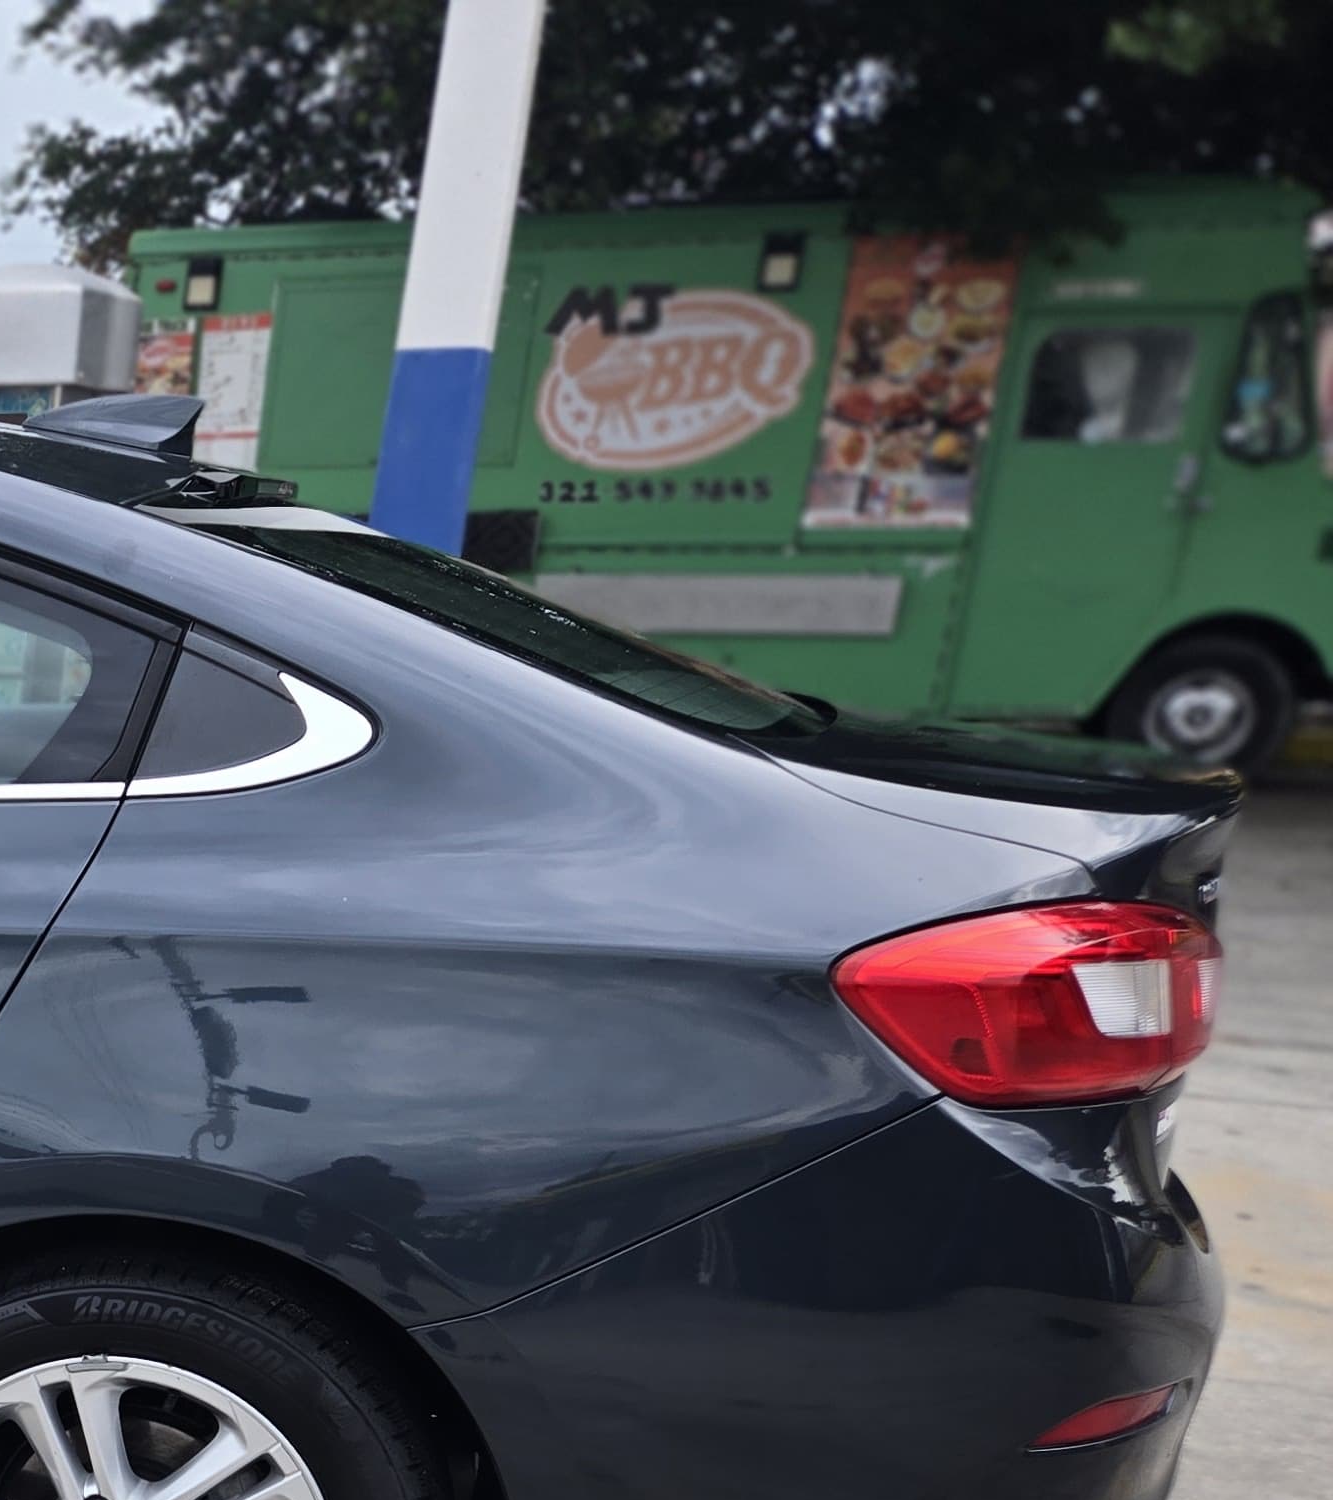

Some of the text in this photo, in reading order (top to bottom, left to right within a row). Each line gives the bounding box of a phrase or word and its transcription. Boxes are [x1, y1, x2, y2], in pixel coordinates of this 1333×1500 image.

[543, 284, 675, 336] MJ
[636, 329, 804, 413] BBQ
[539, 480, 600, 503] 321
[71, 1294, 302, 1384] BRIDGESTONE
